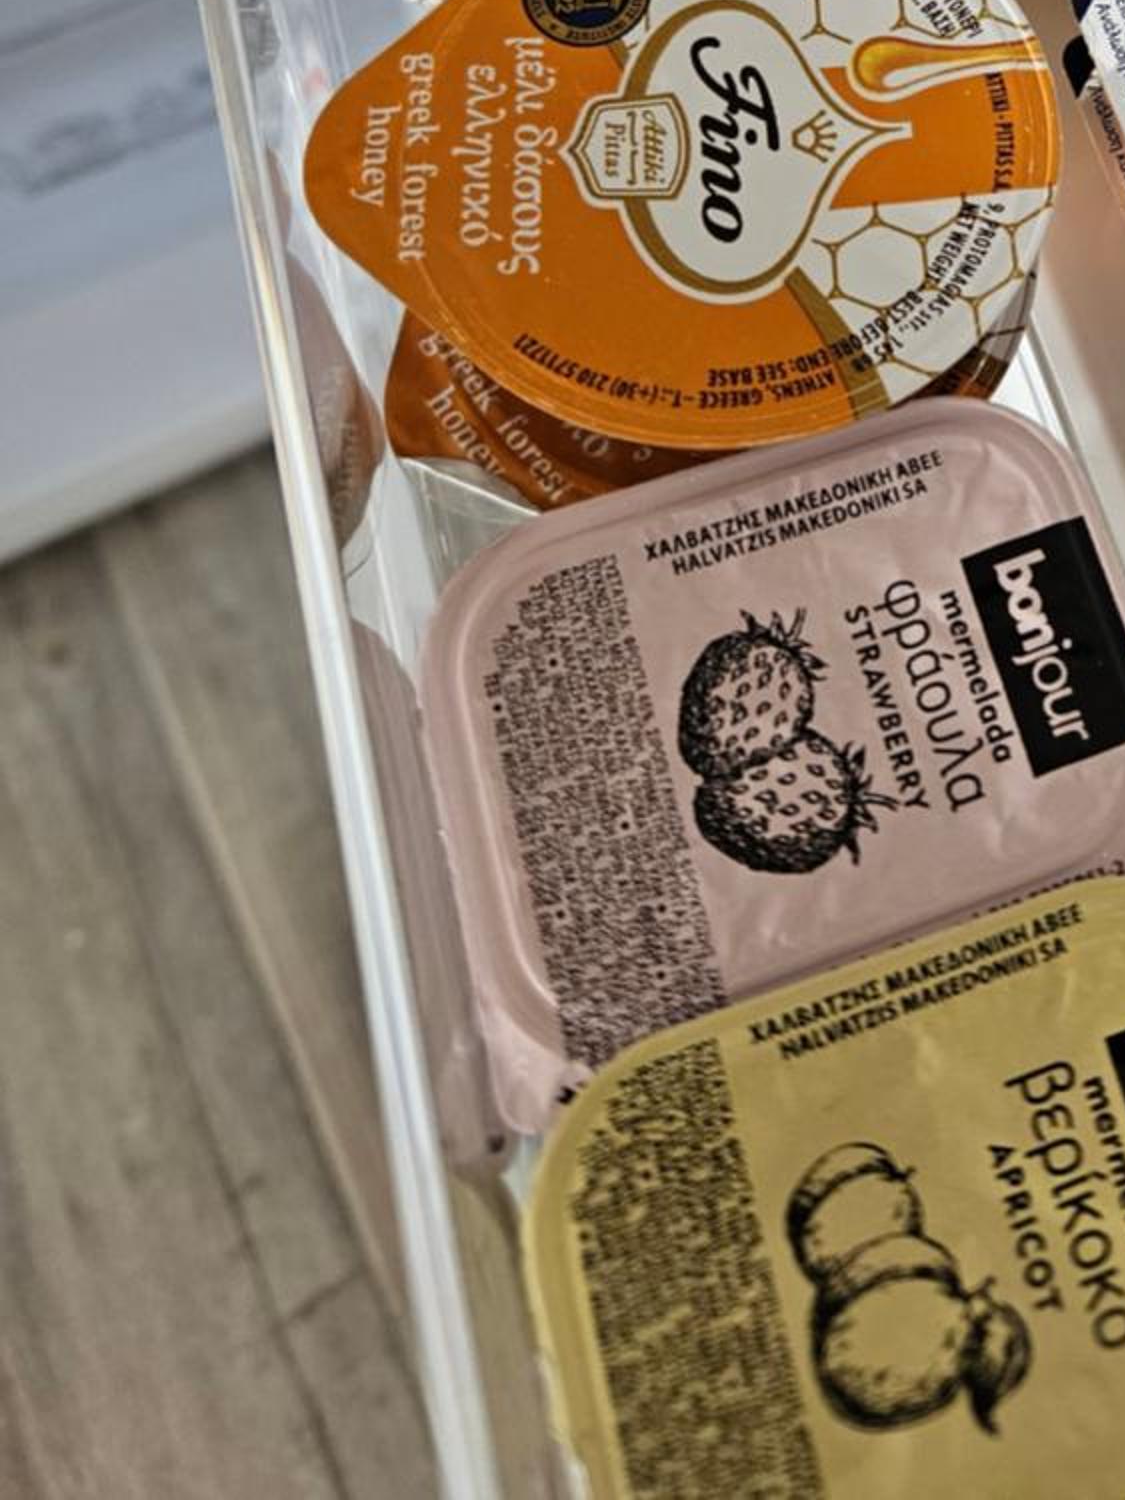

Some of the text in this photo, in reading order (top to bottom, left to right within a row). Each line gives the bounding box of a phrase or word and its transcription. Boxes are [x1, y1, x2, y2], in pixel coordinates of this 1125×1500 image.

[350, 104, 402, 208] honey
[398, 53, 441, 263] greek forest
[690, 36, 780, 243] Fino
[497, 125, 559, 276] δάσους
[926, 231, 968, 285] WEIGHT
[577, 368, 609, 390] 210
[698, 387, 763, 409] GREECE
[707, 367, 754, 388] BASE
[757, 364, 788, 382] SEE
[643, 450, 945, 562] ΧΑΛΒΑΤΖΗΣ ΜΑΚΕΔΟΝΙΚΗ ΑΒΕΕ
[671, 478, 928, 576] HALVATZIS MAKEDONIKI SA
[873, 579, 987, 813] φράουλα
[939, 589, 1015, 764] mermelada
[992, 547, 1089, 741] bonjour
[844, 604, 932, 810] STRAWBERRY
[884, 924, 1029, 993] ΜΑΚΕΔΟΝΙΚΗ
[1030, 903, 1084, 940] ΑΒΕΕ
[899, 953, 1038, 1015] MAKEDONIKI
[1039, 937, 1069, 963] SA
[987, 1144, 1066, 1312] APRICOT
